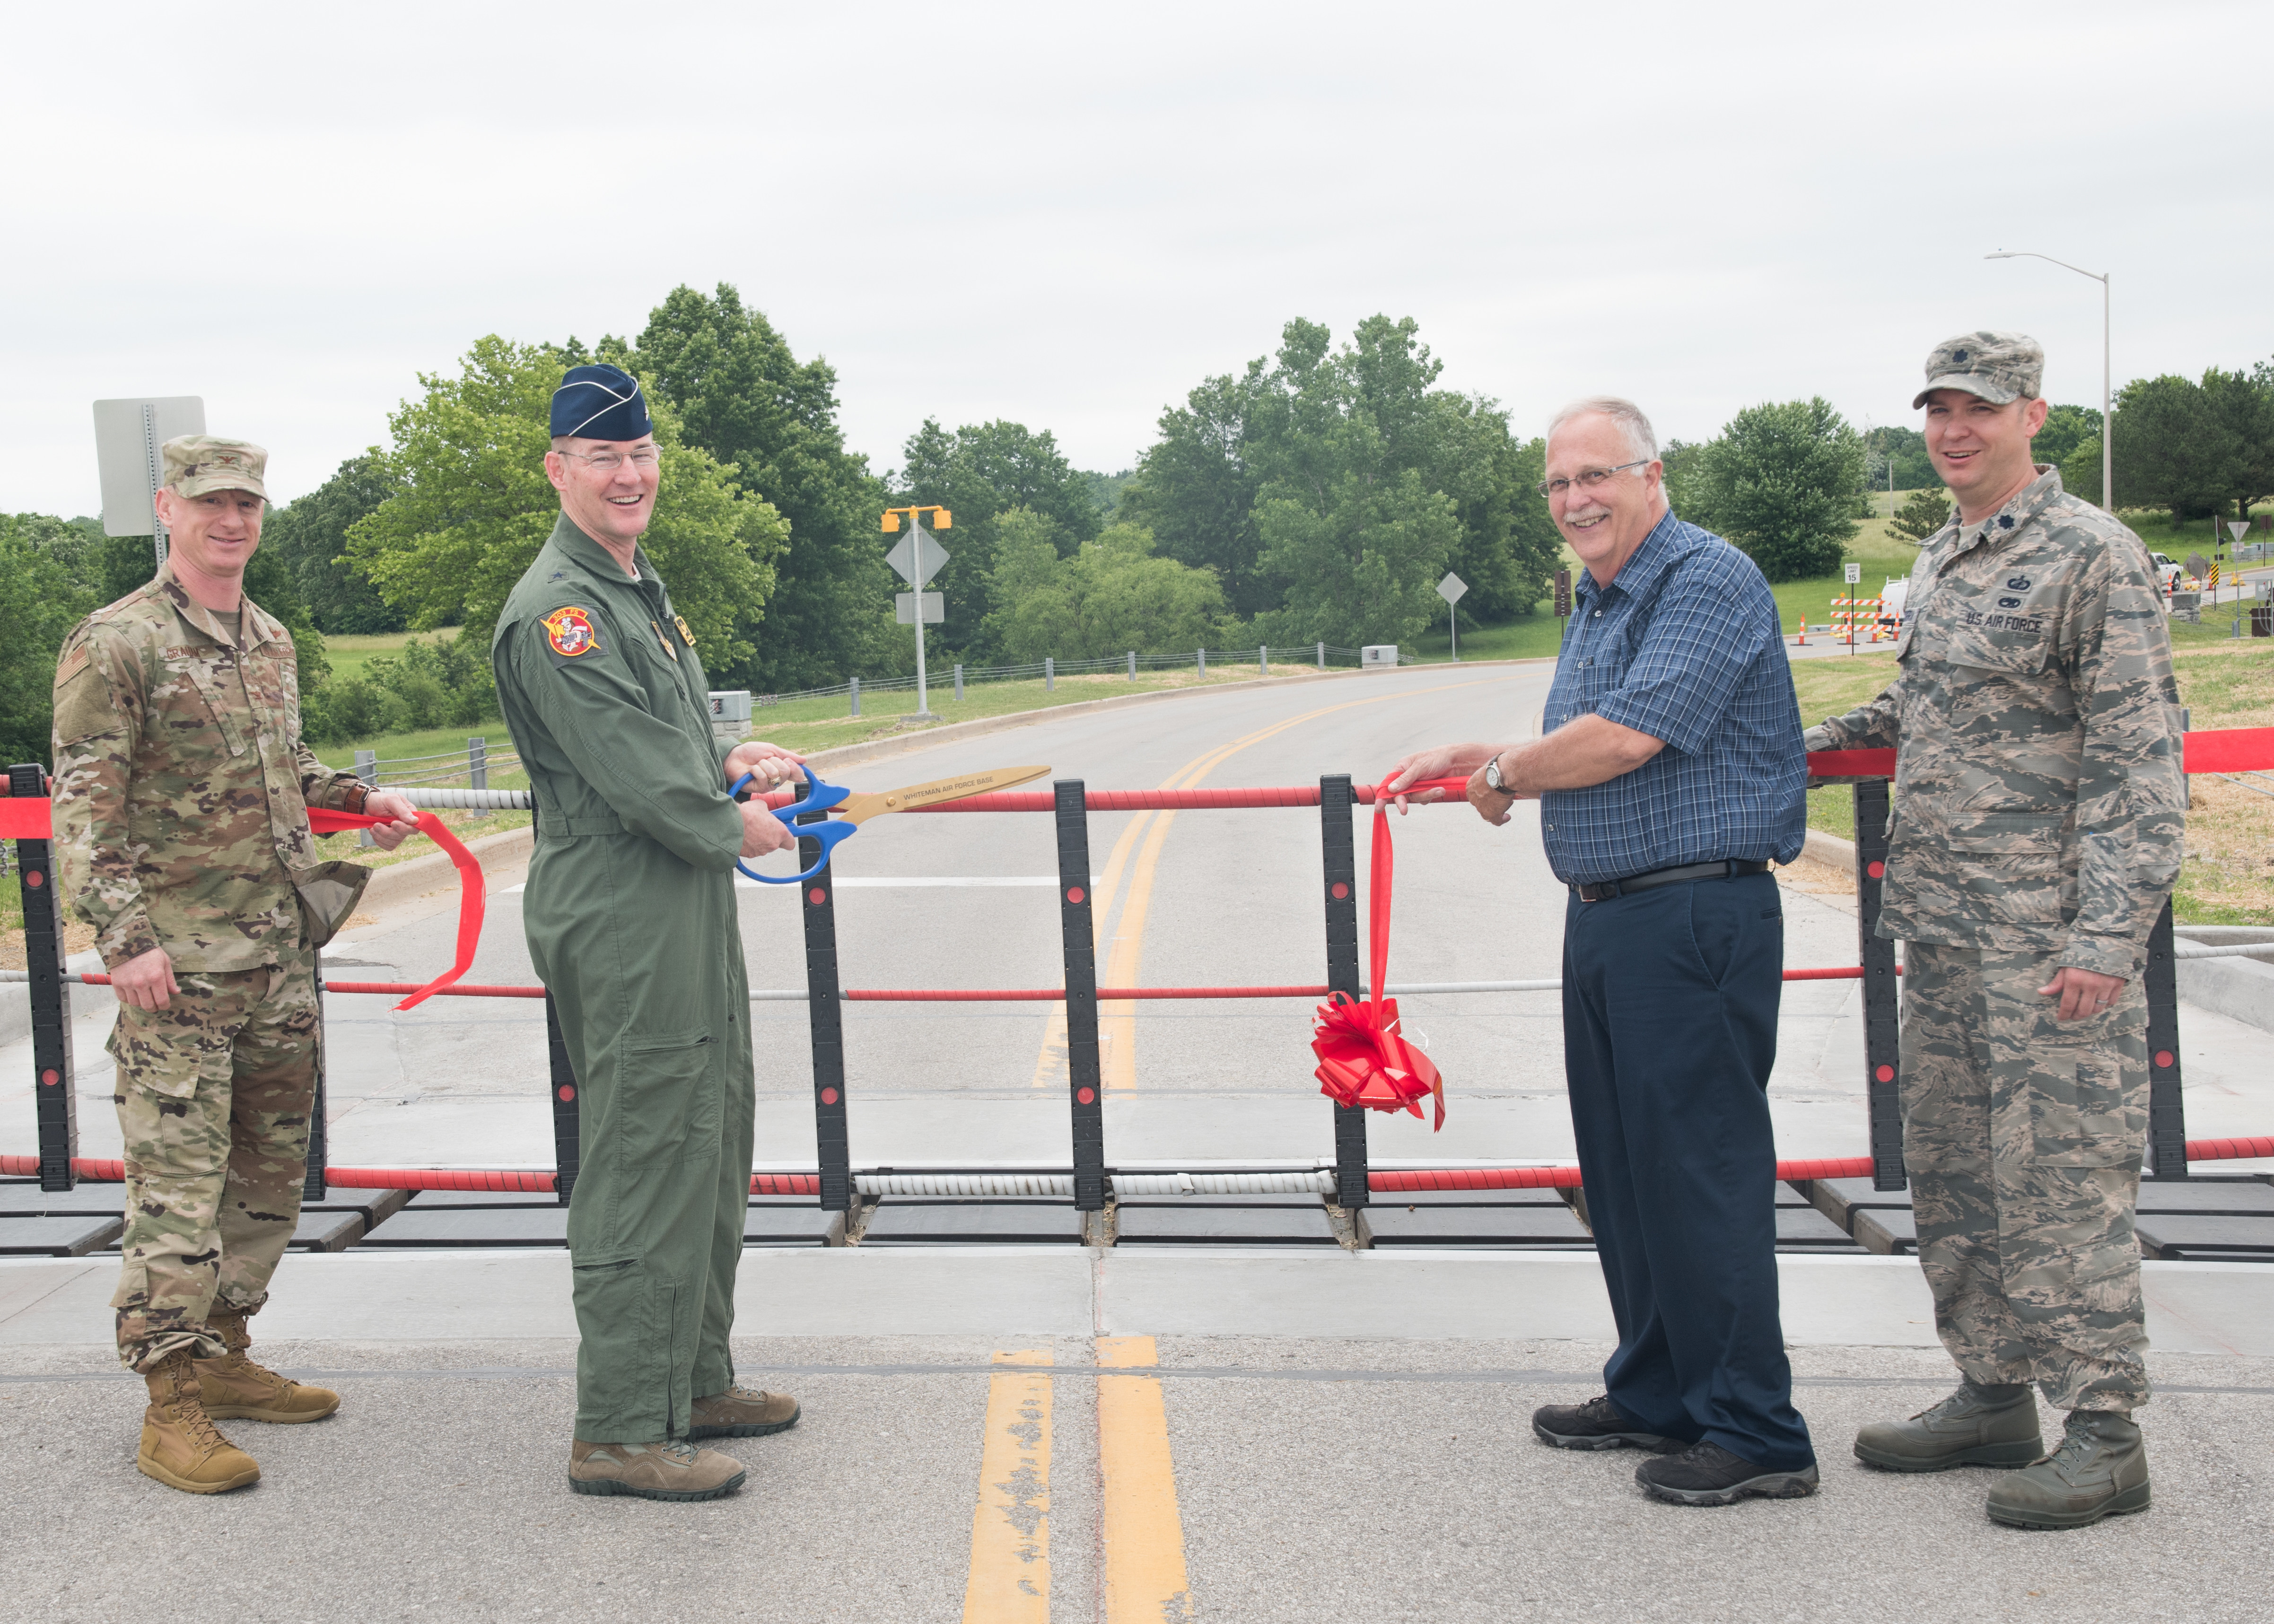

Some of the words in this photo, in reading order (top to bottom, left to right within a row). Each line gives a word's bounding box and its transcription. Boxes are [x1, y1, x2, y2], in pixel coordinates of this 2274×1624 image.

[553, 610, 566, 621] 303
[1967, 612, 1983, 626] U.S.
[1984, 615, 2003, 628] AIR
[2004, 617, 2043, 633] FORCE
[903, 788, 941, 800] WHITEMAN
[954, 781, 975, 790] FORCE
[977, 777, 994, 785] BASE
